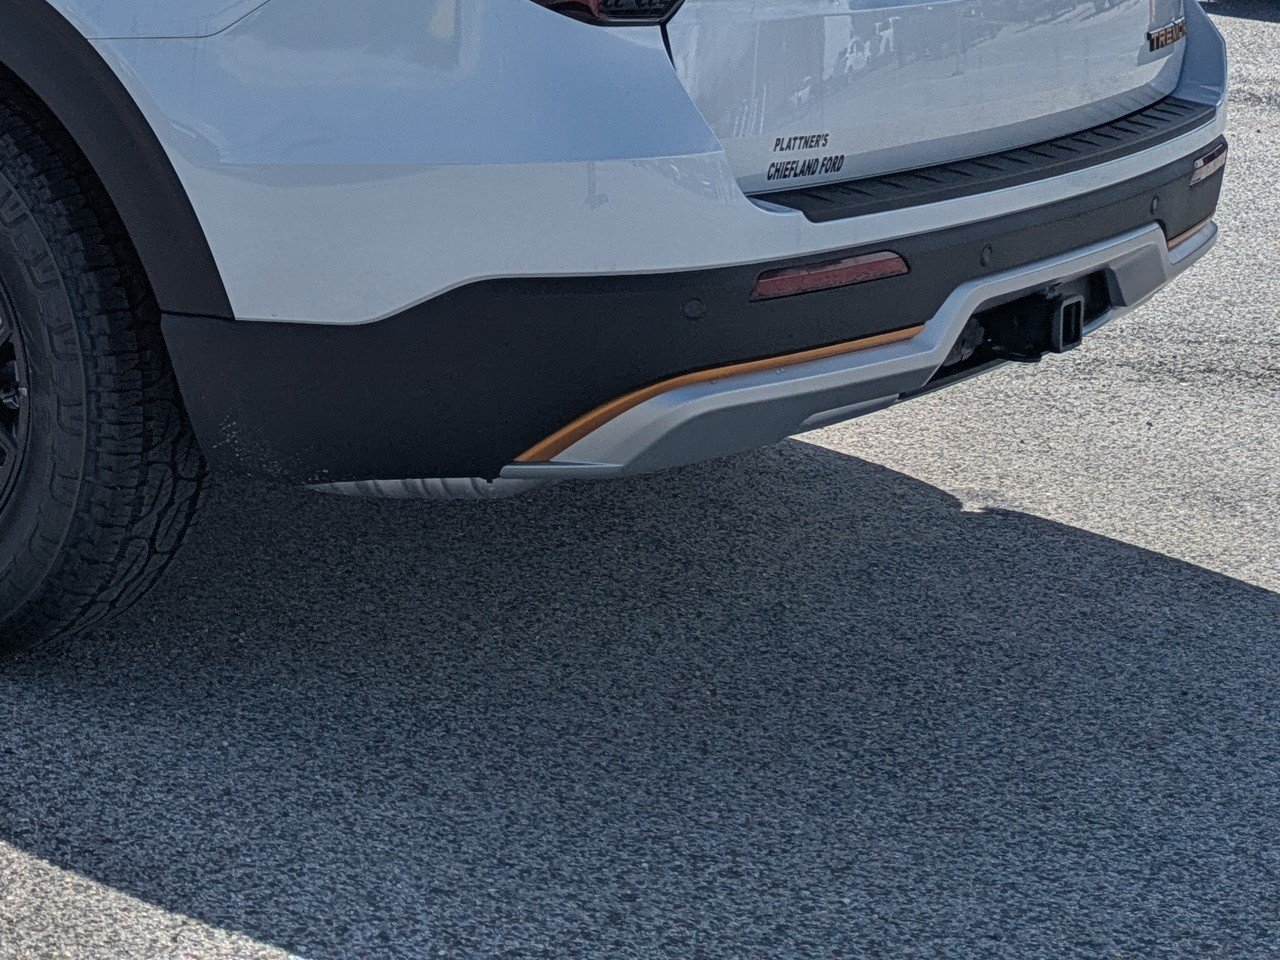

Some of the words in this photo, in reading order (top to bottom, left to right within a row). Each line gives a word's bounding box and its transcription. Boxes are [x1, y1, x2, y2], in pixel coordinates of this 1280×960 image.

[773, 133, 829, 152] PLATTNER'S
[766, 157, 820, 181] CHIEFLAND
[818, 154, 845, 175] FORD
